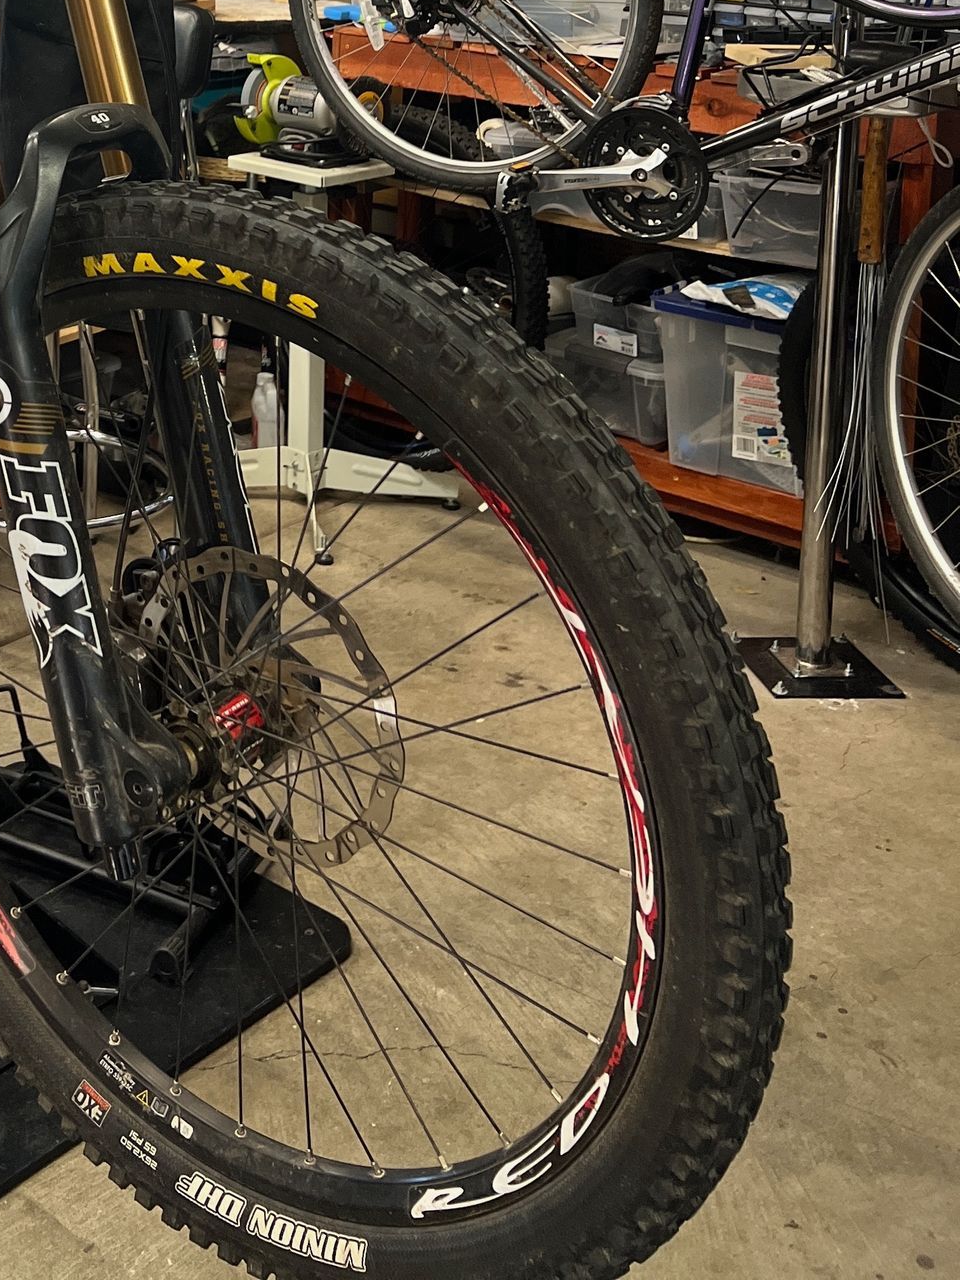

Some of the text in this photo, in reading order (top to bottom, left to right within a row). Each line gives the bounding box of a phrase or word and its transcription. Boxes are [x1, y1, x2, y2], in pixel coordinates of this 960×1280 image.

[90, 112, 111, 124] 40
[780, 45, 960, 135] SCHWIN
[82, 252, 320, 319] MAXXIS
[0, 453, 104, 670] FOX
[74, 1090, 104, 1122] EXO
[120, 1135, 159, 1171] 26X2.50
[128, 1129, 158, 1157] 65 PSI
[409, 1071, 612, 1220] RED
[174, 1170, 368, 1273] MINION DHF
